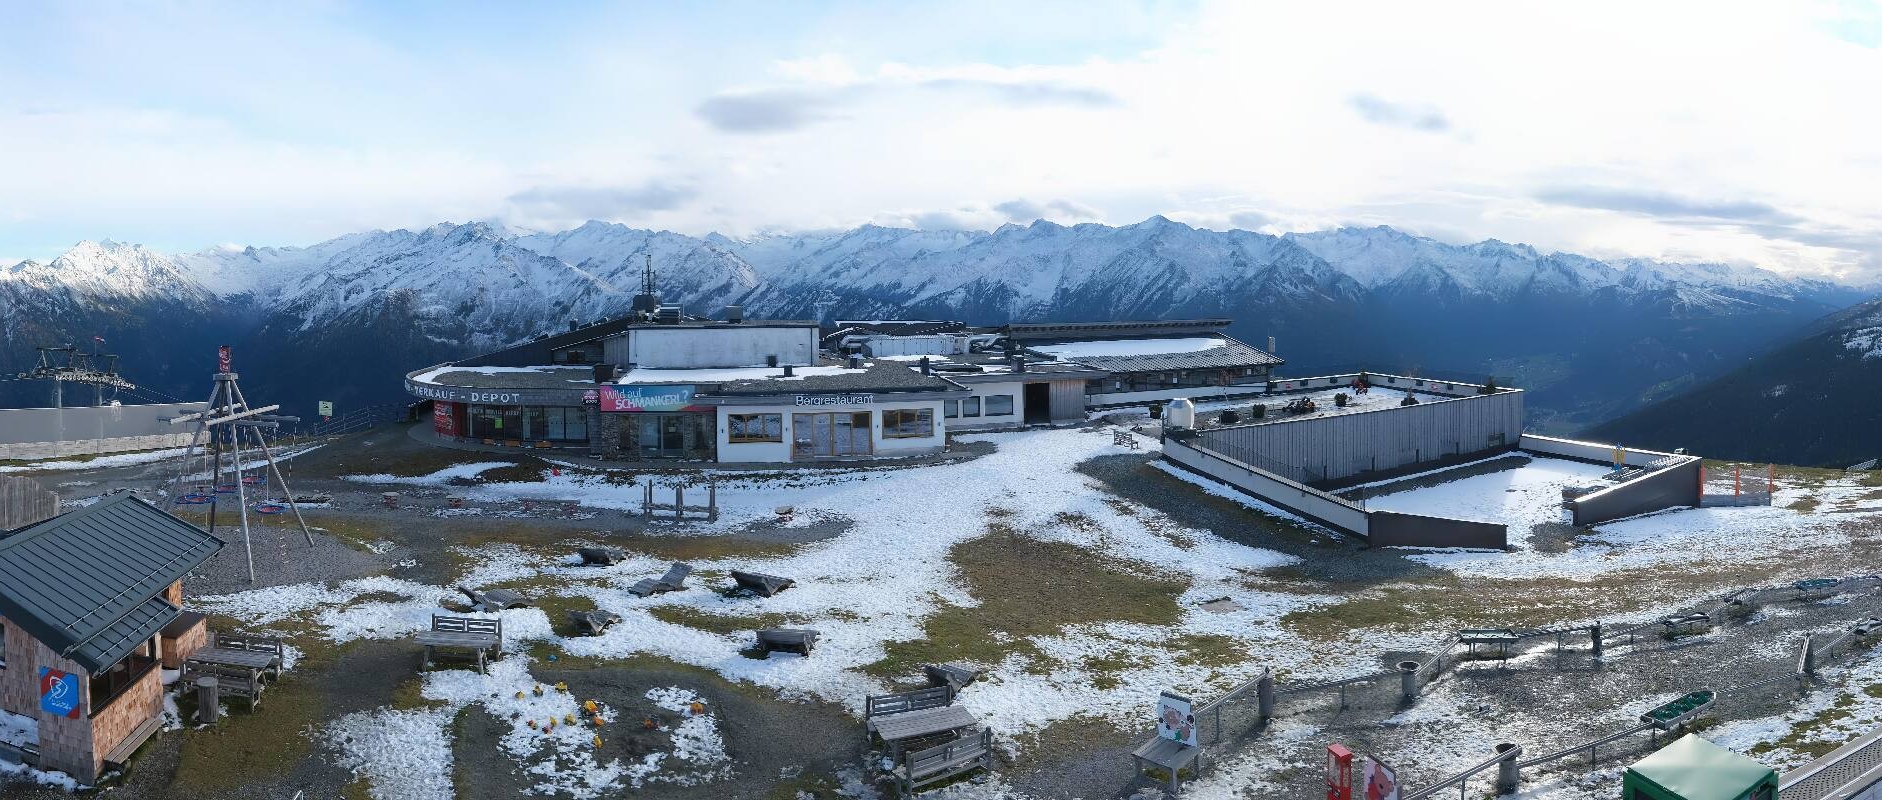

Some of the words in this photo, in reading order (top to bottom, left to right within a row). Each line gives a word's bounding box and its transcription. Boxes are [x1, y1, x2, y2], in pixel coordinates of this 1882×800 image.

[415, 385, 455, 399] VERKAUF
[471, 392, 520, 403] DEPOT
[605, 388, 625, 400] Wild
[627, 387, 643, 398] auf
[615, 390, 689, 410] SCHMANKERL?
[795, 395, 874, 406] Bergrestaurant
